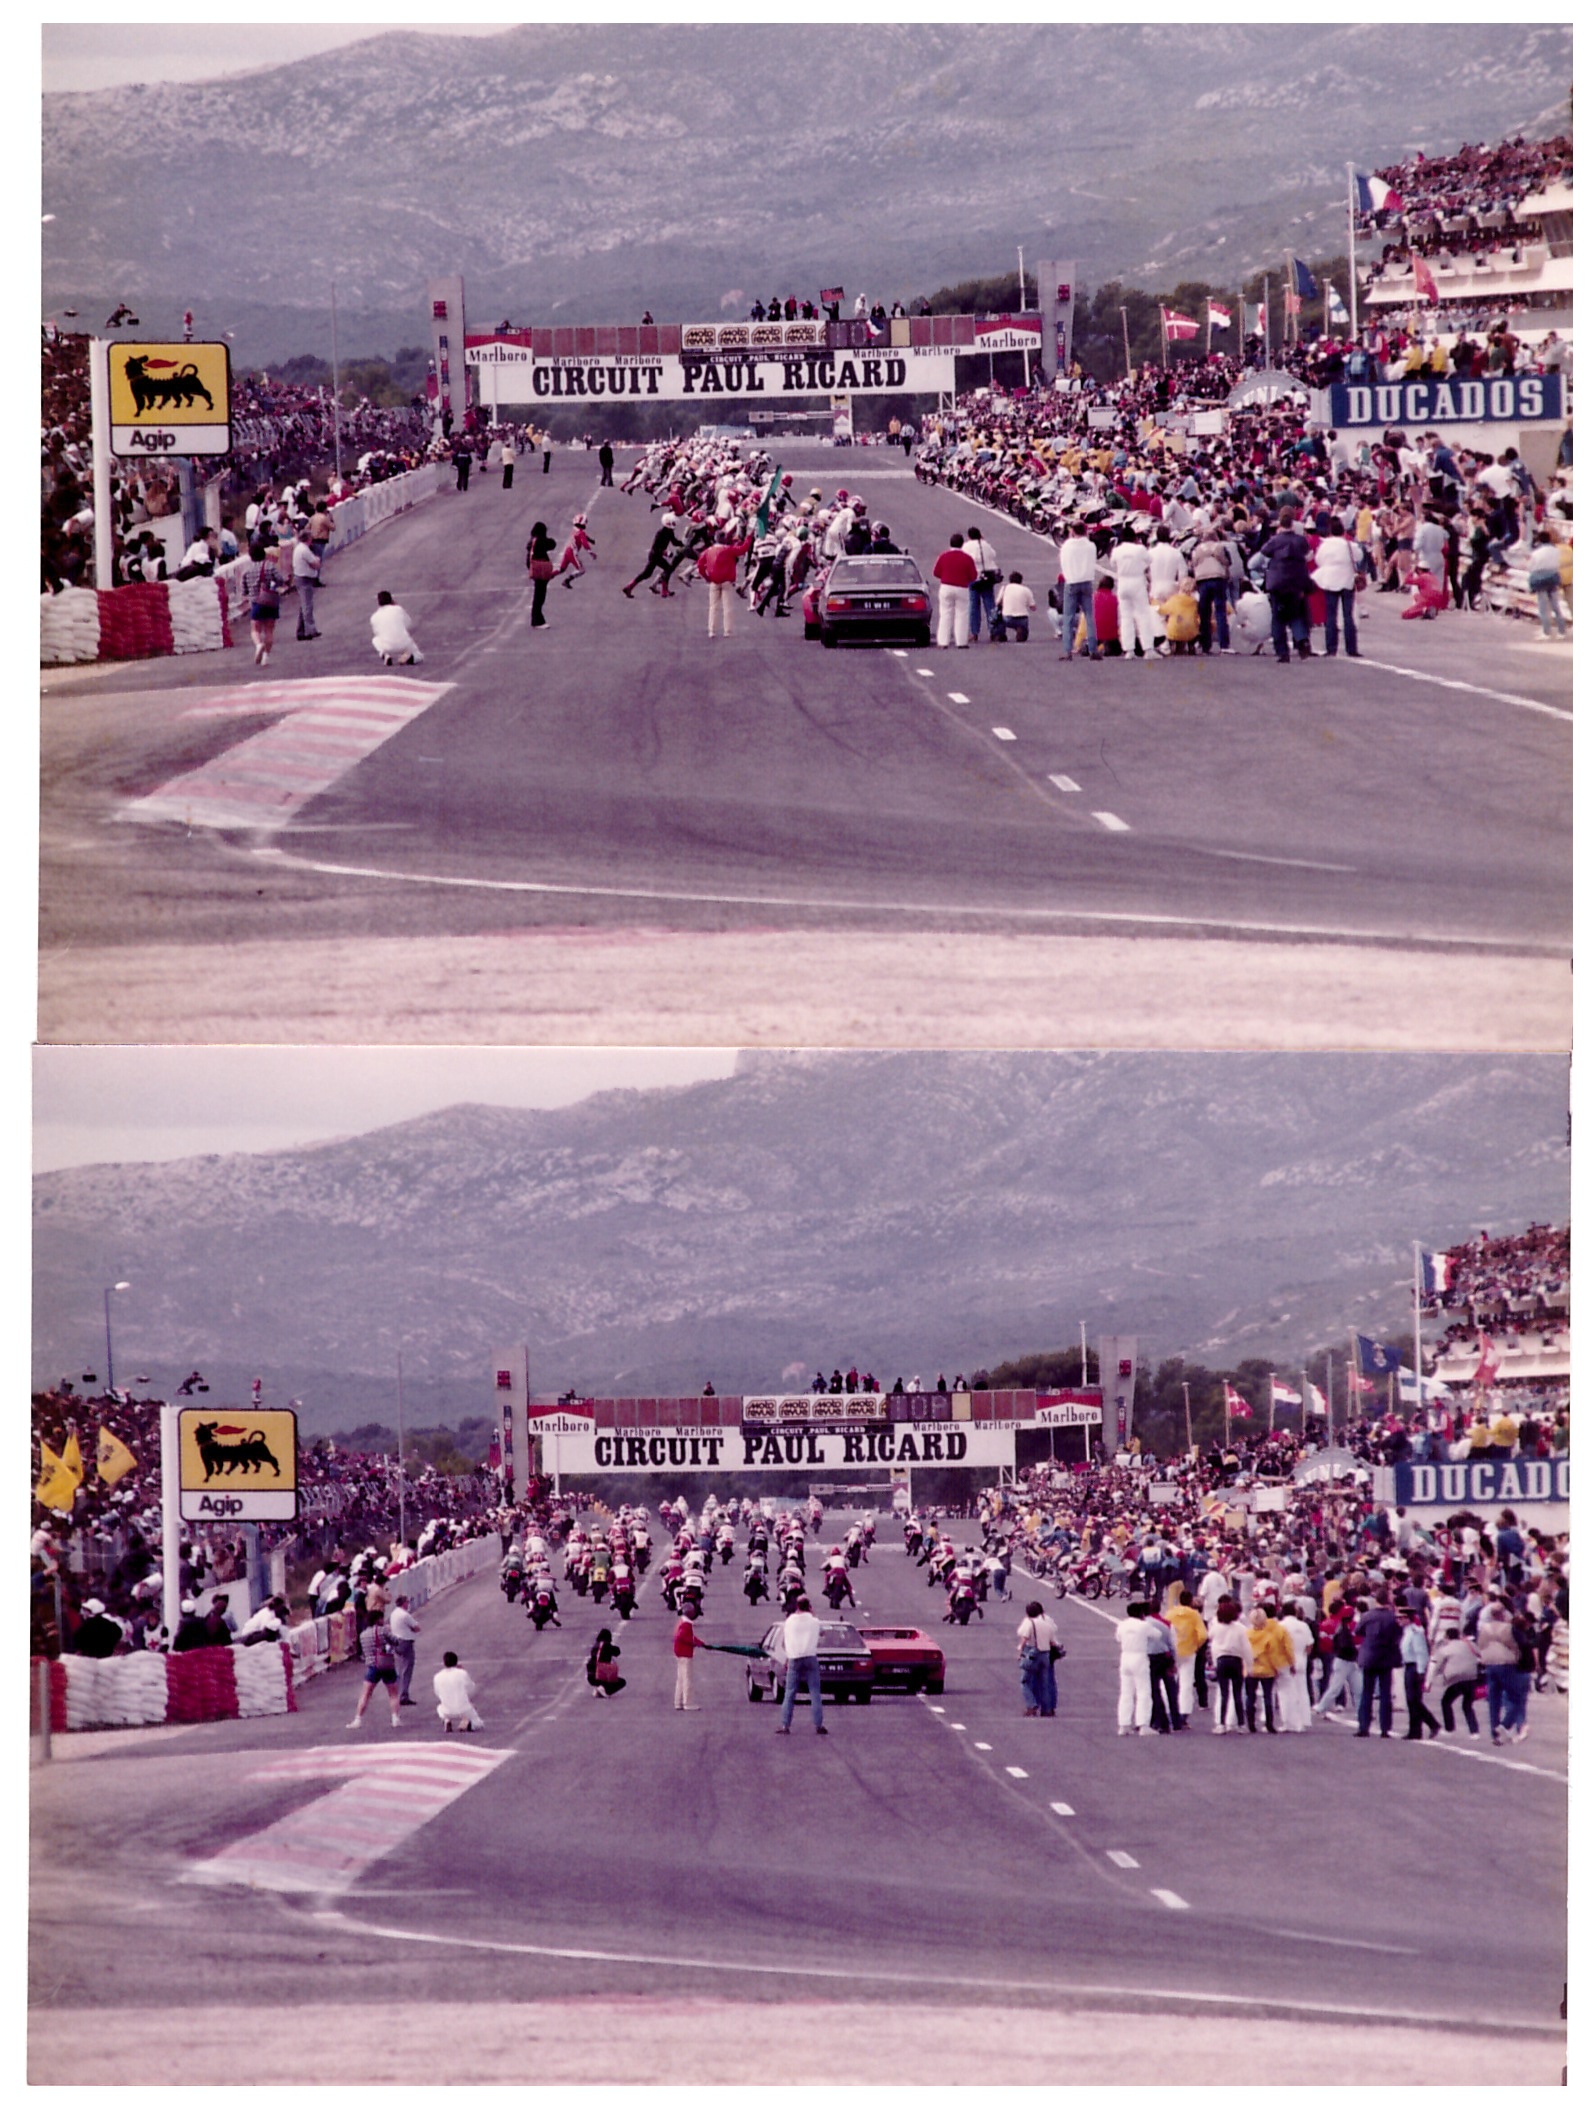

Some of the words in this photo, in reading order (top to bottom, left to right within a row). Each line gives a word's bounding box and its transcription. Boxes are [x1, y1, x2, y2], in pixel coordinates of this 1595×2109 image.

[980, 331, 1038, 349] Marlboro
[469, 346, 528, 362] Marlboro
[710, 355, 743, 364] CIRCUIT
[748, 354, 770, 363] PAUL
[774, 353, 805, 361] RICARD
[532, 366, 663, 397] CIRCUIT
[683, 362, 764, 393] PAUL
[783, 359, 907, 391] RICARD
[1347, 378, 1545, 423] DUCADOS
[130, 430, 176, 451] Agip
[1041, 1406, 1098, 1424] Marlboro
[532, 1416, 590, 1433] Marlboro
[770, 1427, 803, 1436] CIRCUIT
[808, 1426, 831, 1435] PAUL
[835, 1425, 866, 1434] RICARD
[595, 1437, 724, 1467] CIRCUIT
[743, 1433, 825, 1465] PAUL
[843, 1431, 967, 1463] RICARD
[199, 1495, 243, 1516] Agip
